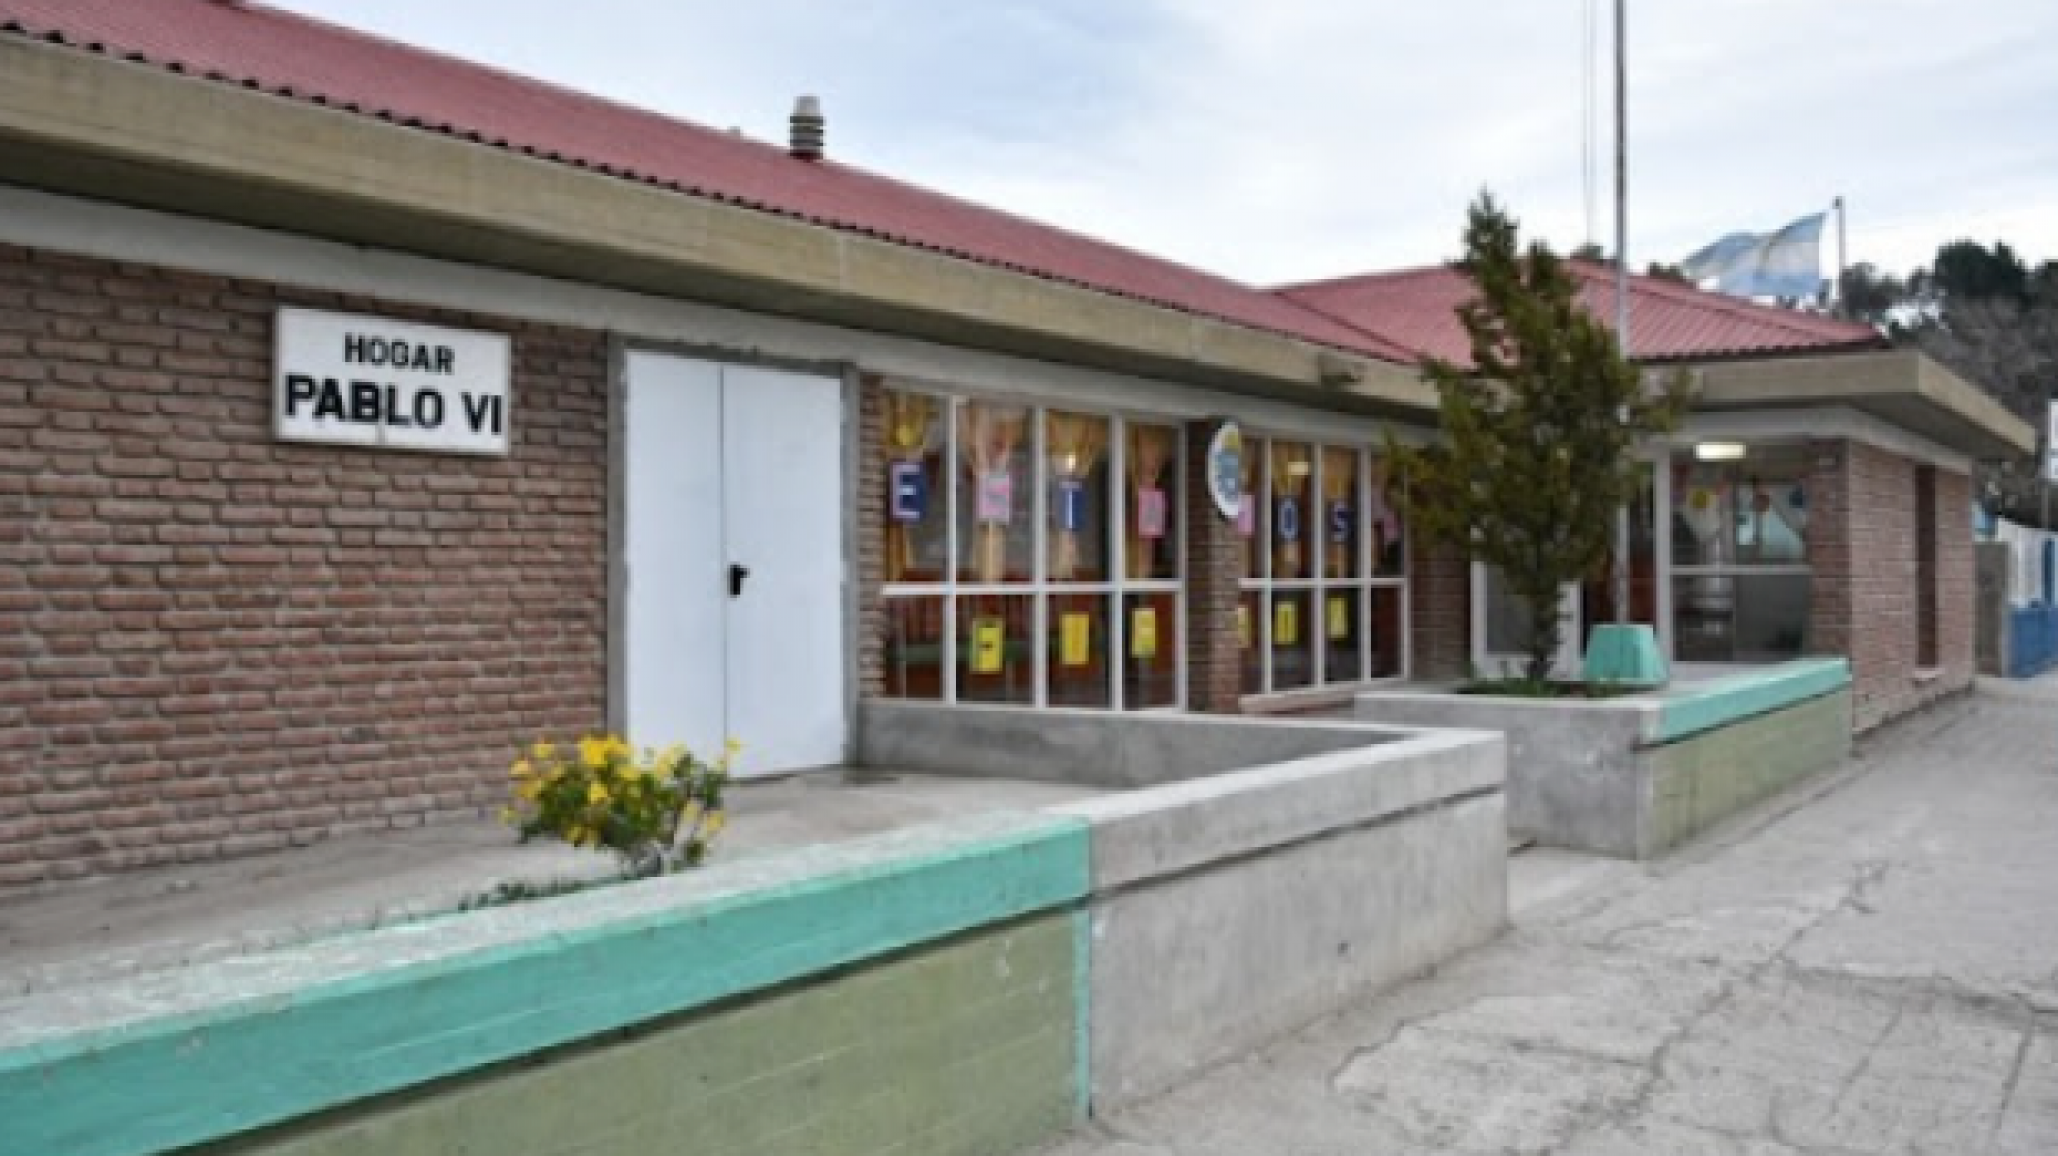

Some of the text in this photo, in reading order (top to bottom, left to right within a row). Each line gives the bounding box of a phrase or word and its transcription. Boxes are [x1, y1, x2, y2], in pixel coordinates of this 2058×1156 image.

[343, 332, 455, 375] HOGAR
[284, 372, 503, 436] PABLO VI
